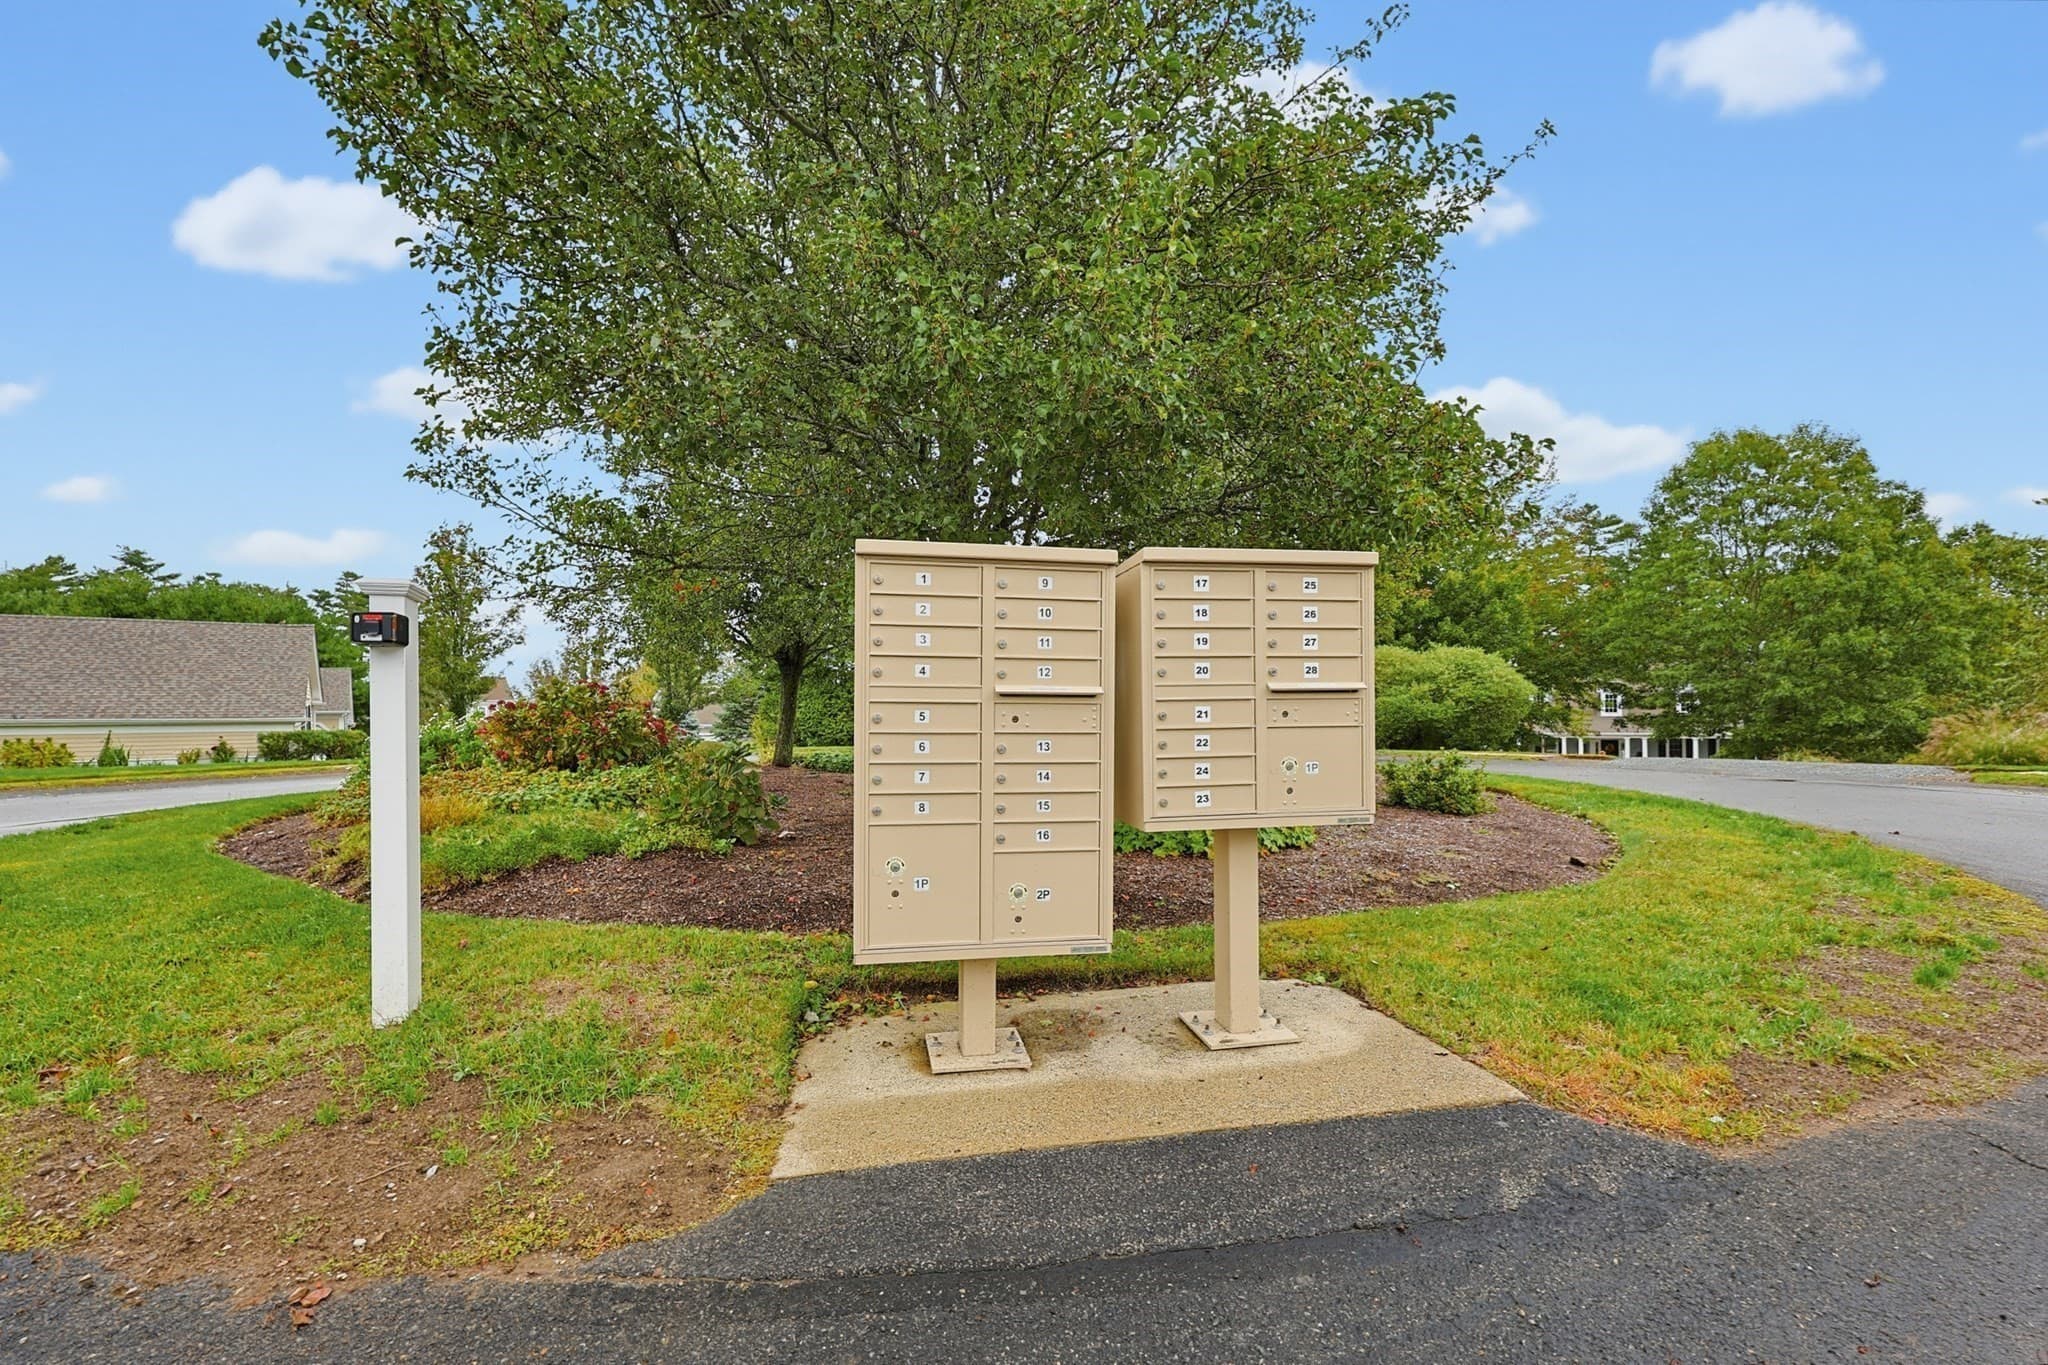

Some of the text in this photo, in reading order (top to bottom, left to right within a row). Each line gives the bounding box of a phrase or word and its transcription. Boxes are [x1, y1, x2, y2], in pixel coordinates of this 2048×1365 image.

[921, 575, 927, 585] 1
[1041, 578, 1049, 588] 9
[1195, 579, 1207, 588] 17
[1303, 581, 1316, 590] 25
[919, 605, 927, 615] 2
[1039, 608, 1051, 618] 10
[1195, 609, 1208, 618] 18
[1303, 610, 1316, 619] 26
[920, 635, 927, 645] 3
[1039, 638, 1049, 648] 11
[1195, 637, 1208, 646] 19
[1304, 638, 1316, 647] 27
[918, 667, 927, 676] 4
[1038, 668, 1050, 678] 12
[1195, 666, 1208, 675] 20
[1305, 666, 1317, 675] 28
[918, 712, 926, 722] 5
[1196, 710, 1208, 719] 21
[918, 742, 926, 752] 6
[1037, 742, 1050, 752] 13
[1195, 739, 1208, 748] 22
[1195, 767, 1208, 776] 24
[1306, 763, 1319, 772] 1P
[918, 772, 926, 782] 7
[1037, 772, 1049, 782] 14
[1196, 795, 1209, 804] 23
[918, 803, 926, 813] 8
[1037, 801, 1050, 811] 15
[1036, 831, 1049, 841] 16
[914, 879, 928, 889] 1P
[1036, 890, 1050, 900] 2P
